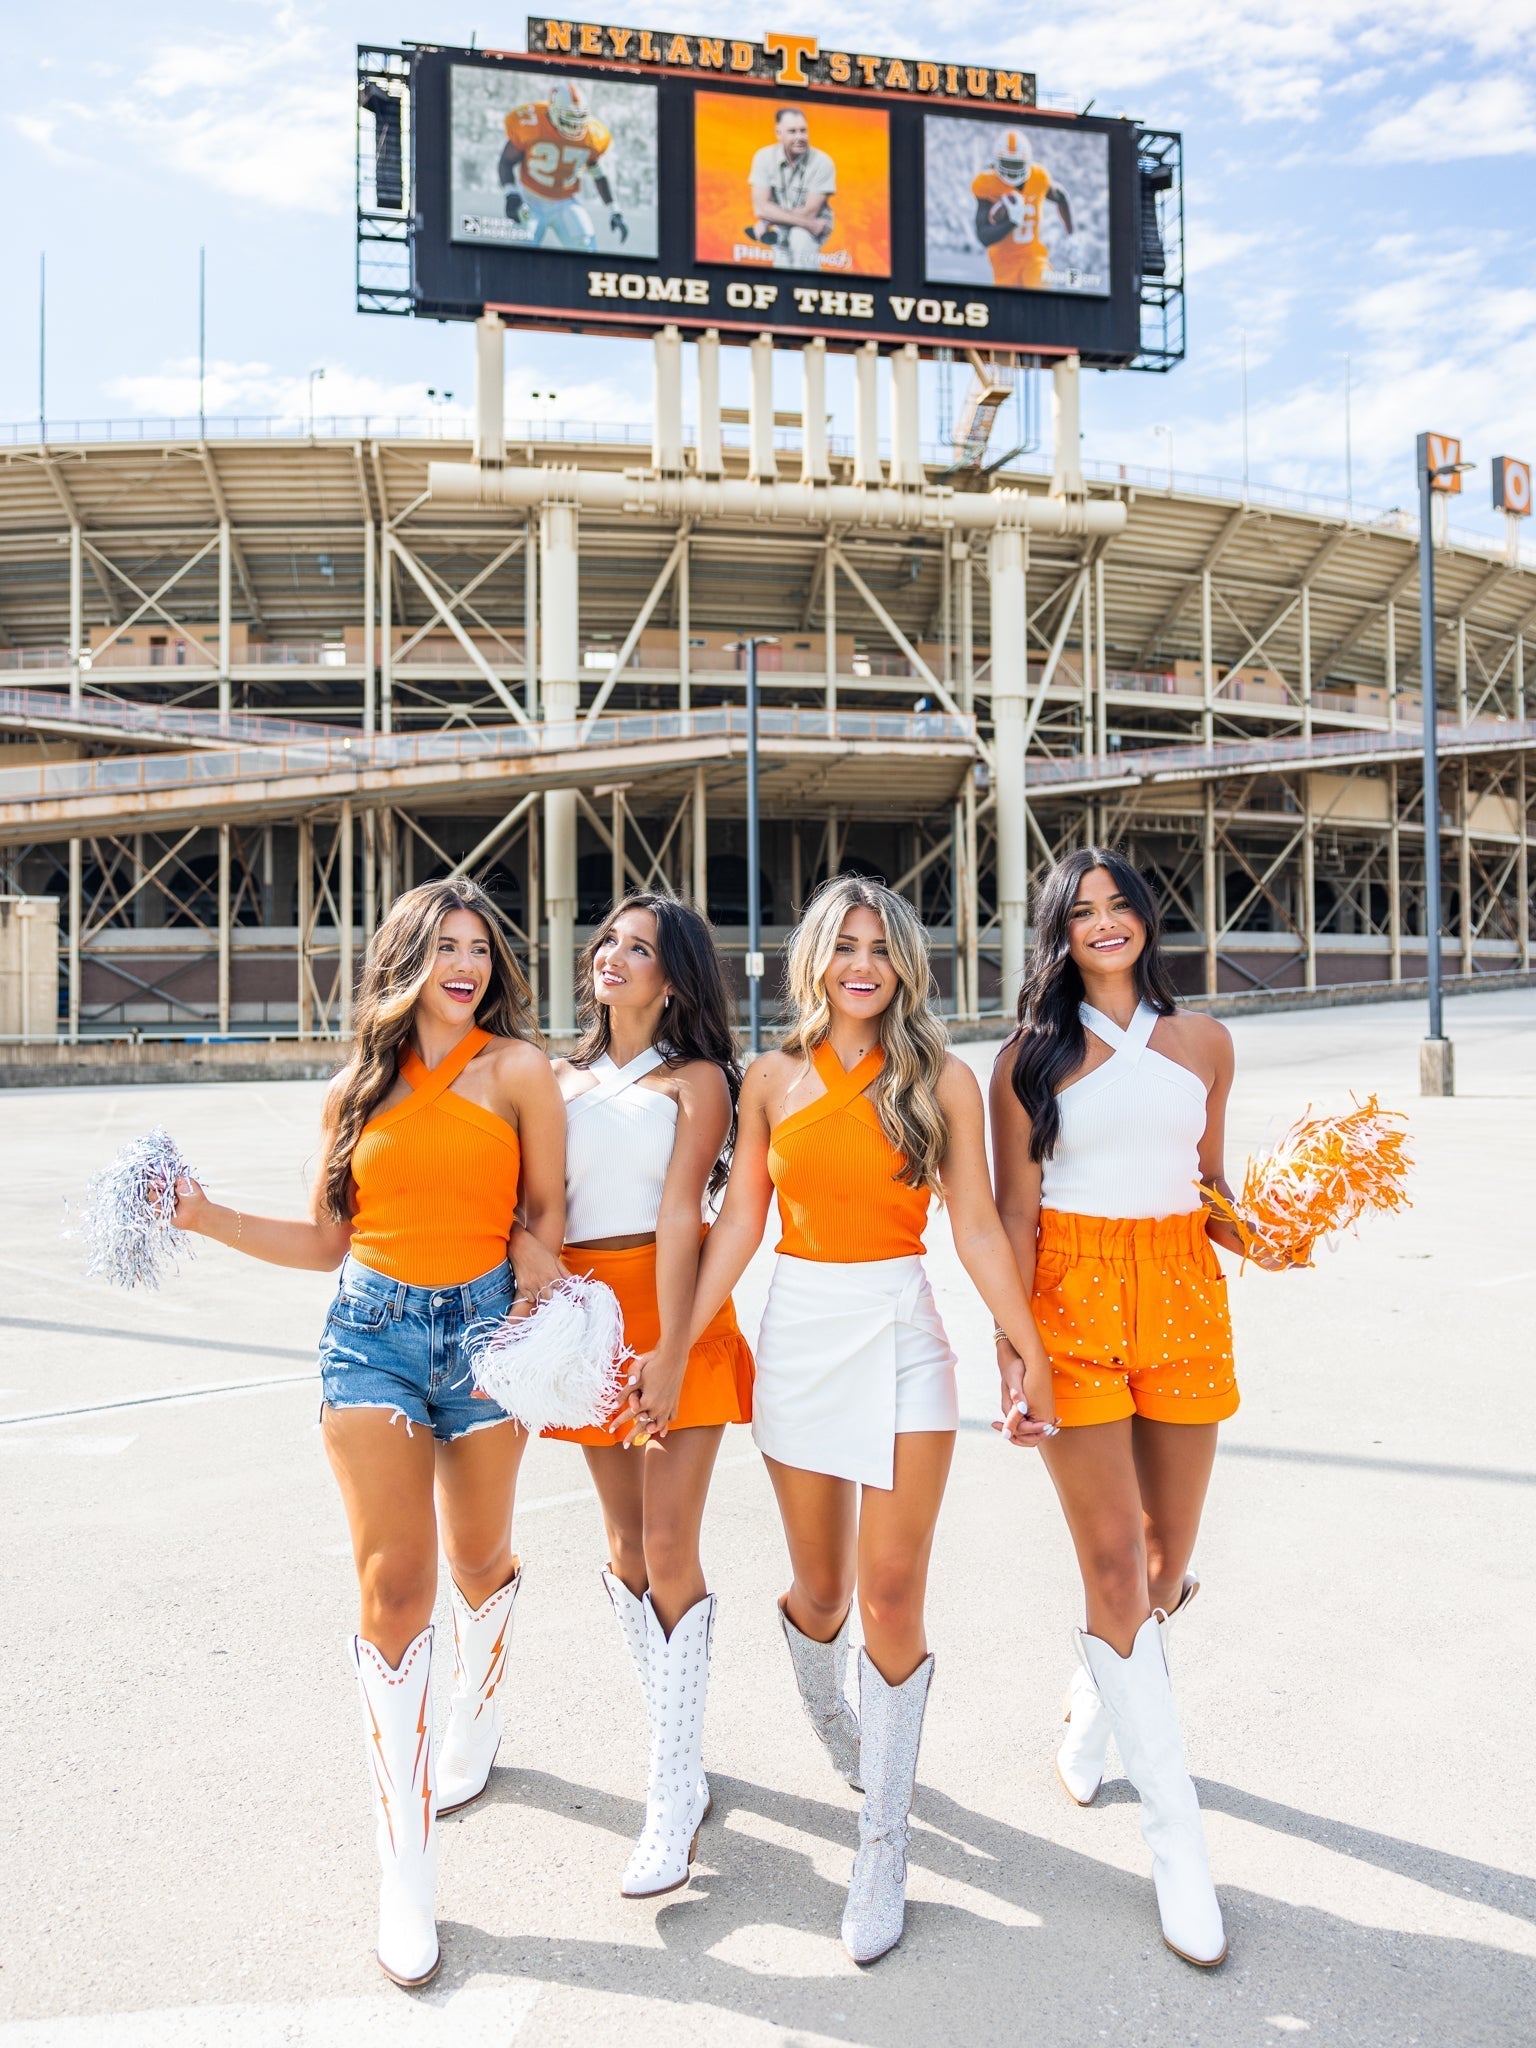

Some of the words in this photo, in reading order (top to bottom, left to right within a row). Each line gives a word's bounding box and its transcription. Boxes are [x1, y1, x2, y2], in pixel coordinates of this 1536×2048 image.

[545, 20, 753, 72] NEYLAND
[764, 31, 819, 87] T
[829, 52, 1024, 100] STADIUM
[528, 142, 591, 187] 27
[587, 271, 710, 305] HOME
[726, 282, 778, 310] OF
[793, 287, 875, 319] THE
[889, 296, 990, 328] VOLS
[1505, 461, 1529, 509] O
